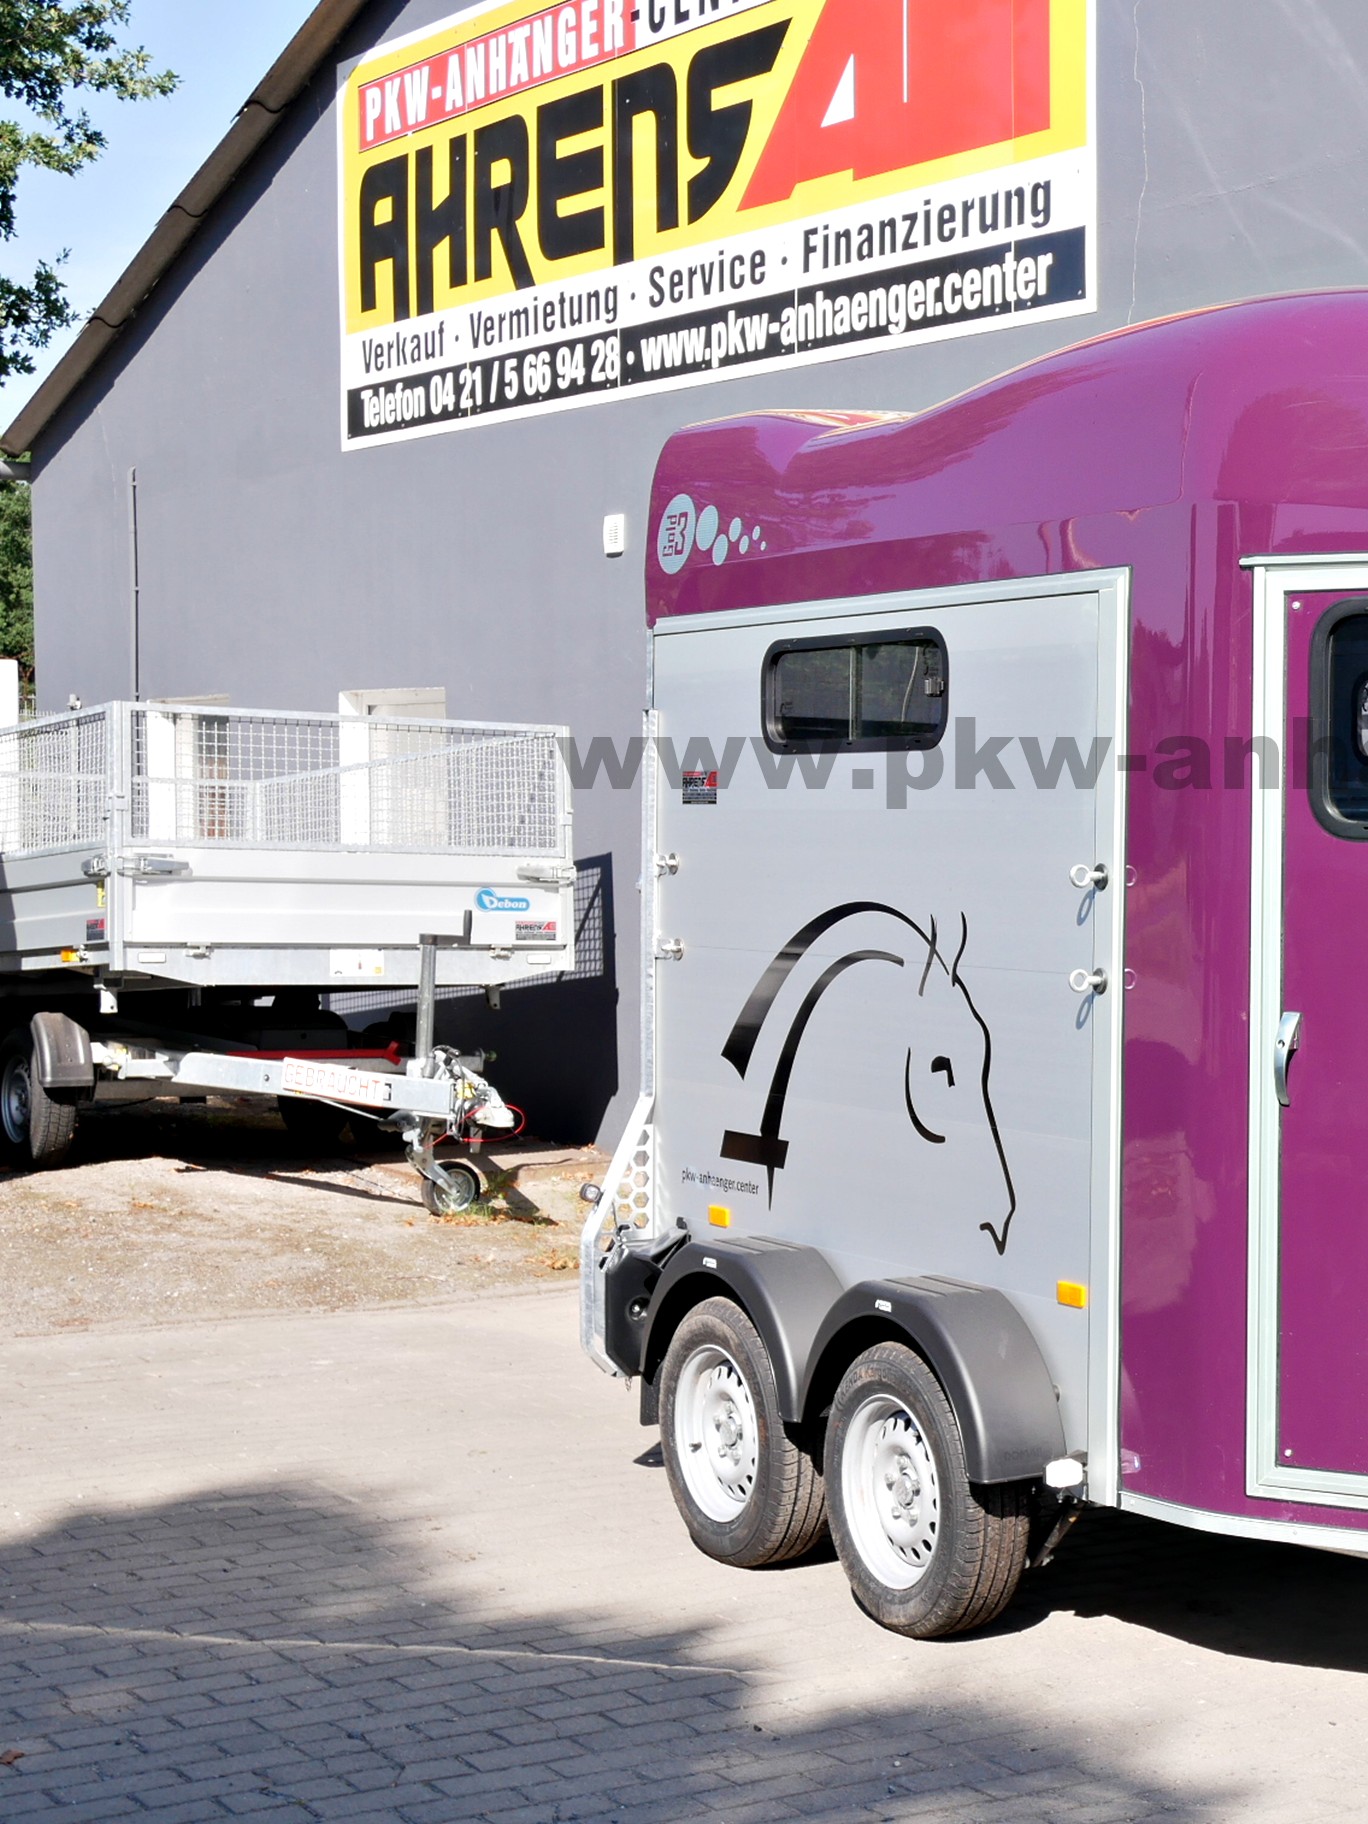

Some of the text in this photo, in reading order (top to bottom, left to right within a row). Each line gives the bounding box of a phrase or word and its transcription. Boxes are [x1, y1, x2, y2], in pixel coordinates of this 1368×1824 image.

[359, 17, 793, 322] AHRENS
[362, 179, 1052, 374] Verkauf Vermietung Service Finanzierung
[360, 382, 425, 428] Telefon
[430, 372, 455, 415] 04
[459, 366, 483, 411] 21
[504, 355, 519, 401] 5
[523, 350, 551, 397] 66
[556, 343, 586, 390] 94
[591, 336, 619, 383] 28
[640, 248, 1053, 372] www.pkw-anhaenger.center
[481, 893, 527, 909] Debon
[284, 1063, 380, 1099] GEBRAUCHT
[681, 1167, 760, 1195] pkw-anhaenger.center
